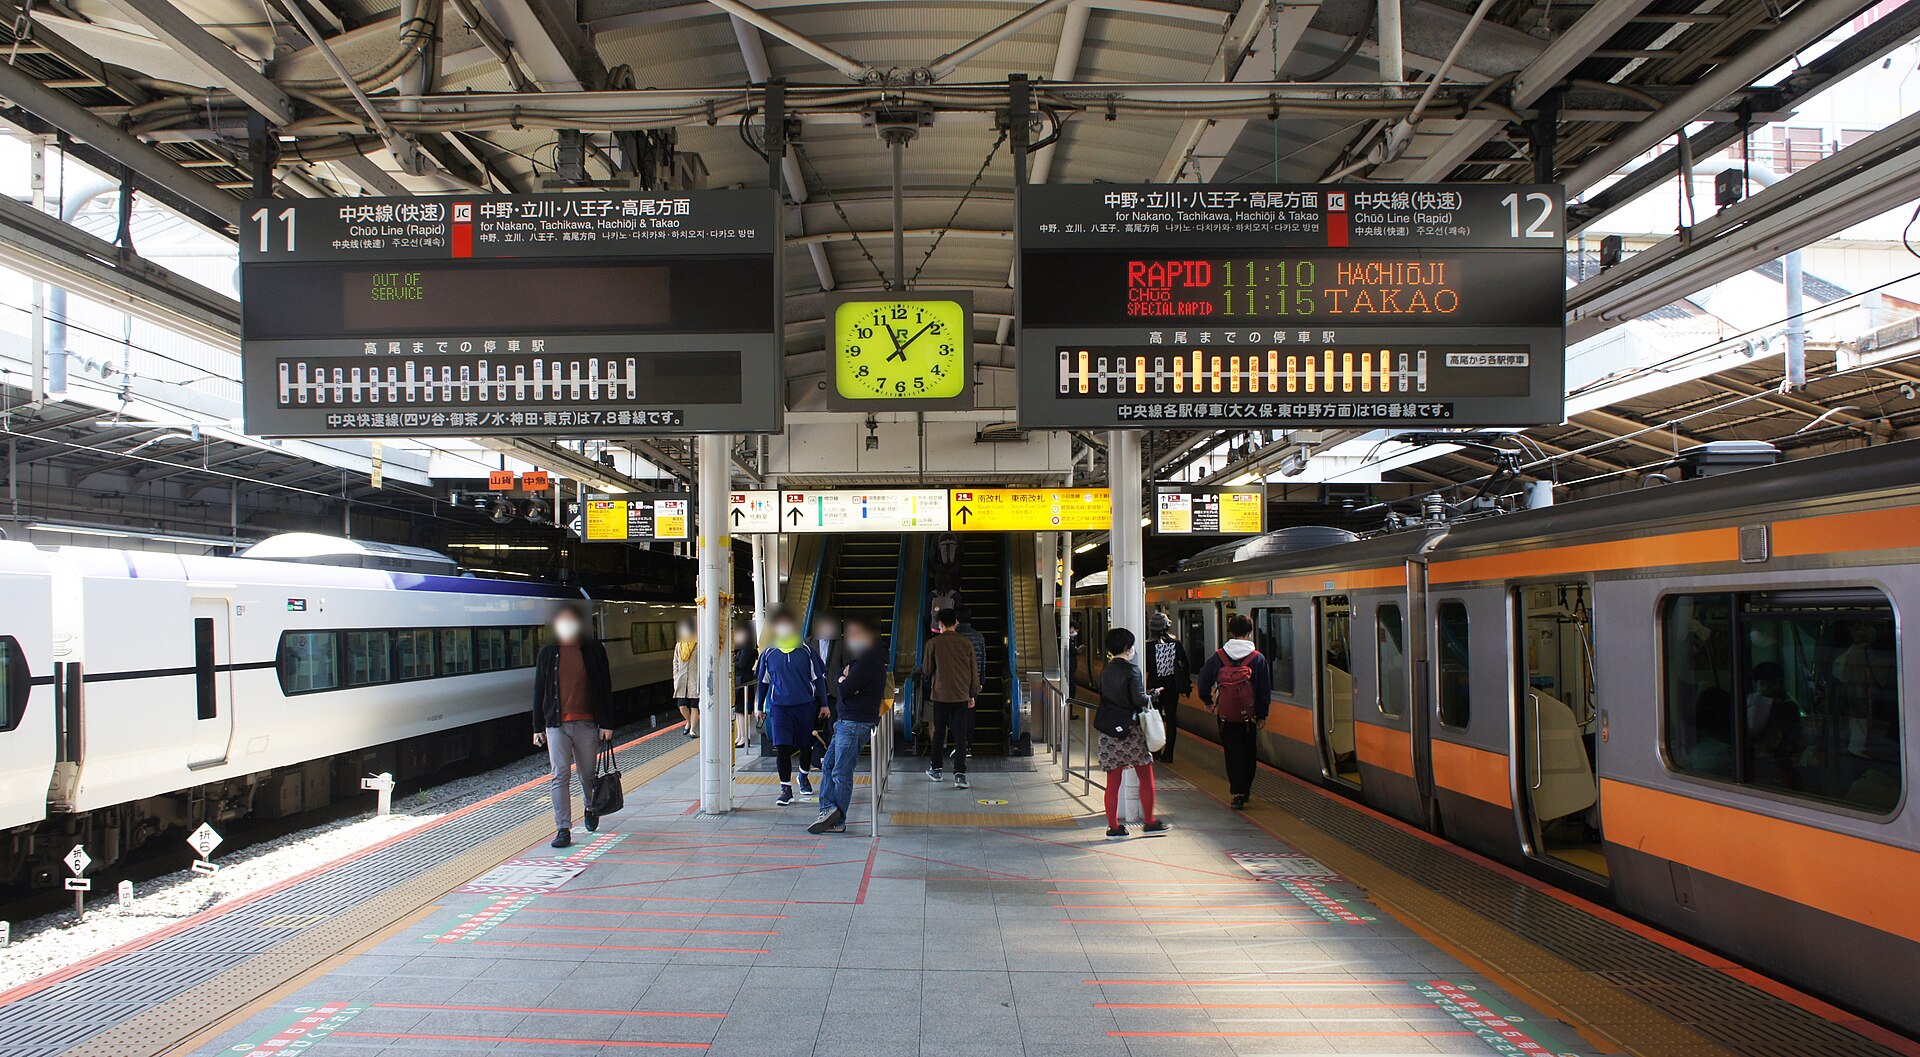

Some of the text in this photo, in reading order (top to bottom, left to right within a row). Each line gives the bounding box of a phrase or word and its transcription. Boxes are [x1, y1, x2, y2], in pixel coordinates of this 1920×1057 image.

[1104, 191, 1318, 209] 中野・立川・八王子・高尾方面
[1329, 195, 1344, 207] JC
[1354, 191, 1464, 210] 中央線(快速)
[339, 203, 446, 223] 中央線(快速)
[456, 207, 470, 219] JC
[480, 198, 691, 219] 中野・立川・八王子・高尾方面
[1500, 192, 1554, 238] 12
[1116, 211, 1319, 223] for Nakano, Tachikawa, Hachiōji & Takao
[1354, 212, 1453, 225] Chūō Line (Rapid)
[251, 207, 297, 252] 11
[349, 224, 446, 237] Chūō Line (Rapid)
[480, 218, 680, 232] for Nakano, Tachikawa, Hachiōji & Takao
[372, 272, 421, 286] OUT OF
[1128, 261, 1211, 287] RAPID
[1223, 261, 1315, 287] 11:10
[371, 286, 423, 300] SERVICE
[1223, 289, 1458, 315] 11:15 TAKAO
[891, 308, 908, 319] 12
[1127, 302, 1212, 316] SPECIAL RAPID
[873, 315, 887, 326] 11
[916, 313, 922, 324] 1
[857, 328, 873, 339] 10
[930, 324, 941, 335] 2
[1150, 331, 1335, 344] 高尾までの停車駅
[364, 340, 546, 355] 高尾までの停車駅
[850, 346, 861, 357] 9
[939, 344, 950, 356] 3
[1449, 355, 1525, 366] 高尾から各駅停車
[858, 366, 869, 377] 8
[930, 364, 941, 375] 4
[1080, 354, 1088, 391] 中野
[1268, 353, 1276, 390] 国分寺
[1306, 359, 1314, 389] 国立
[1326, 353, 1334, 389] 立川
[1344, 355, 1352, 389] 日野
[1400, 355, 1408, 390] 西八王子
[535, 361, 542, 398] 立川
[876, 378, 887, 389] 7
[913, 377, 924, 388] 5
[895, 381, 906, 392] 6
[977, 494, 1003, 503] 南改札
[1011, 494, 1046, 503] 東南改札
